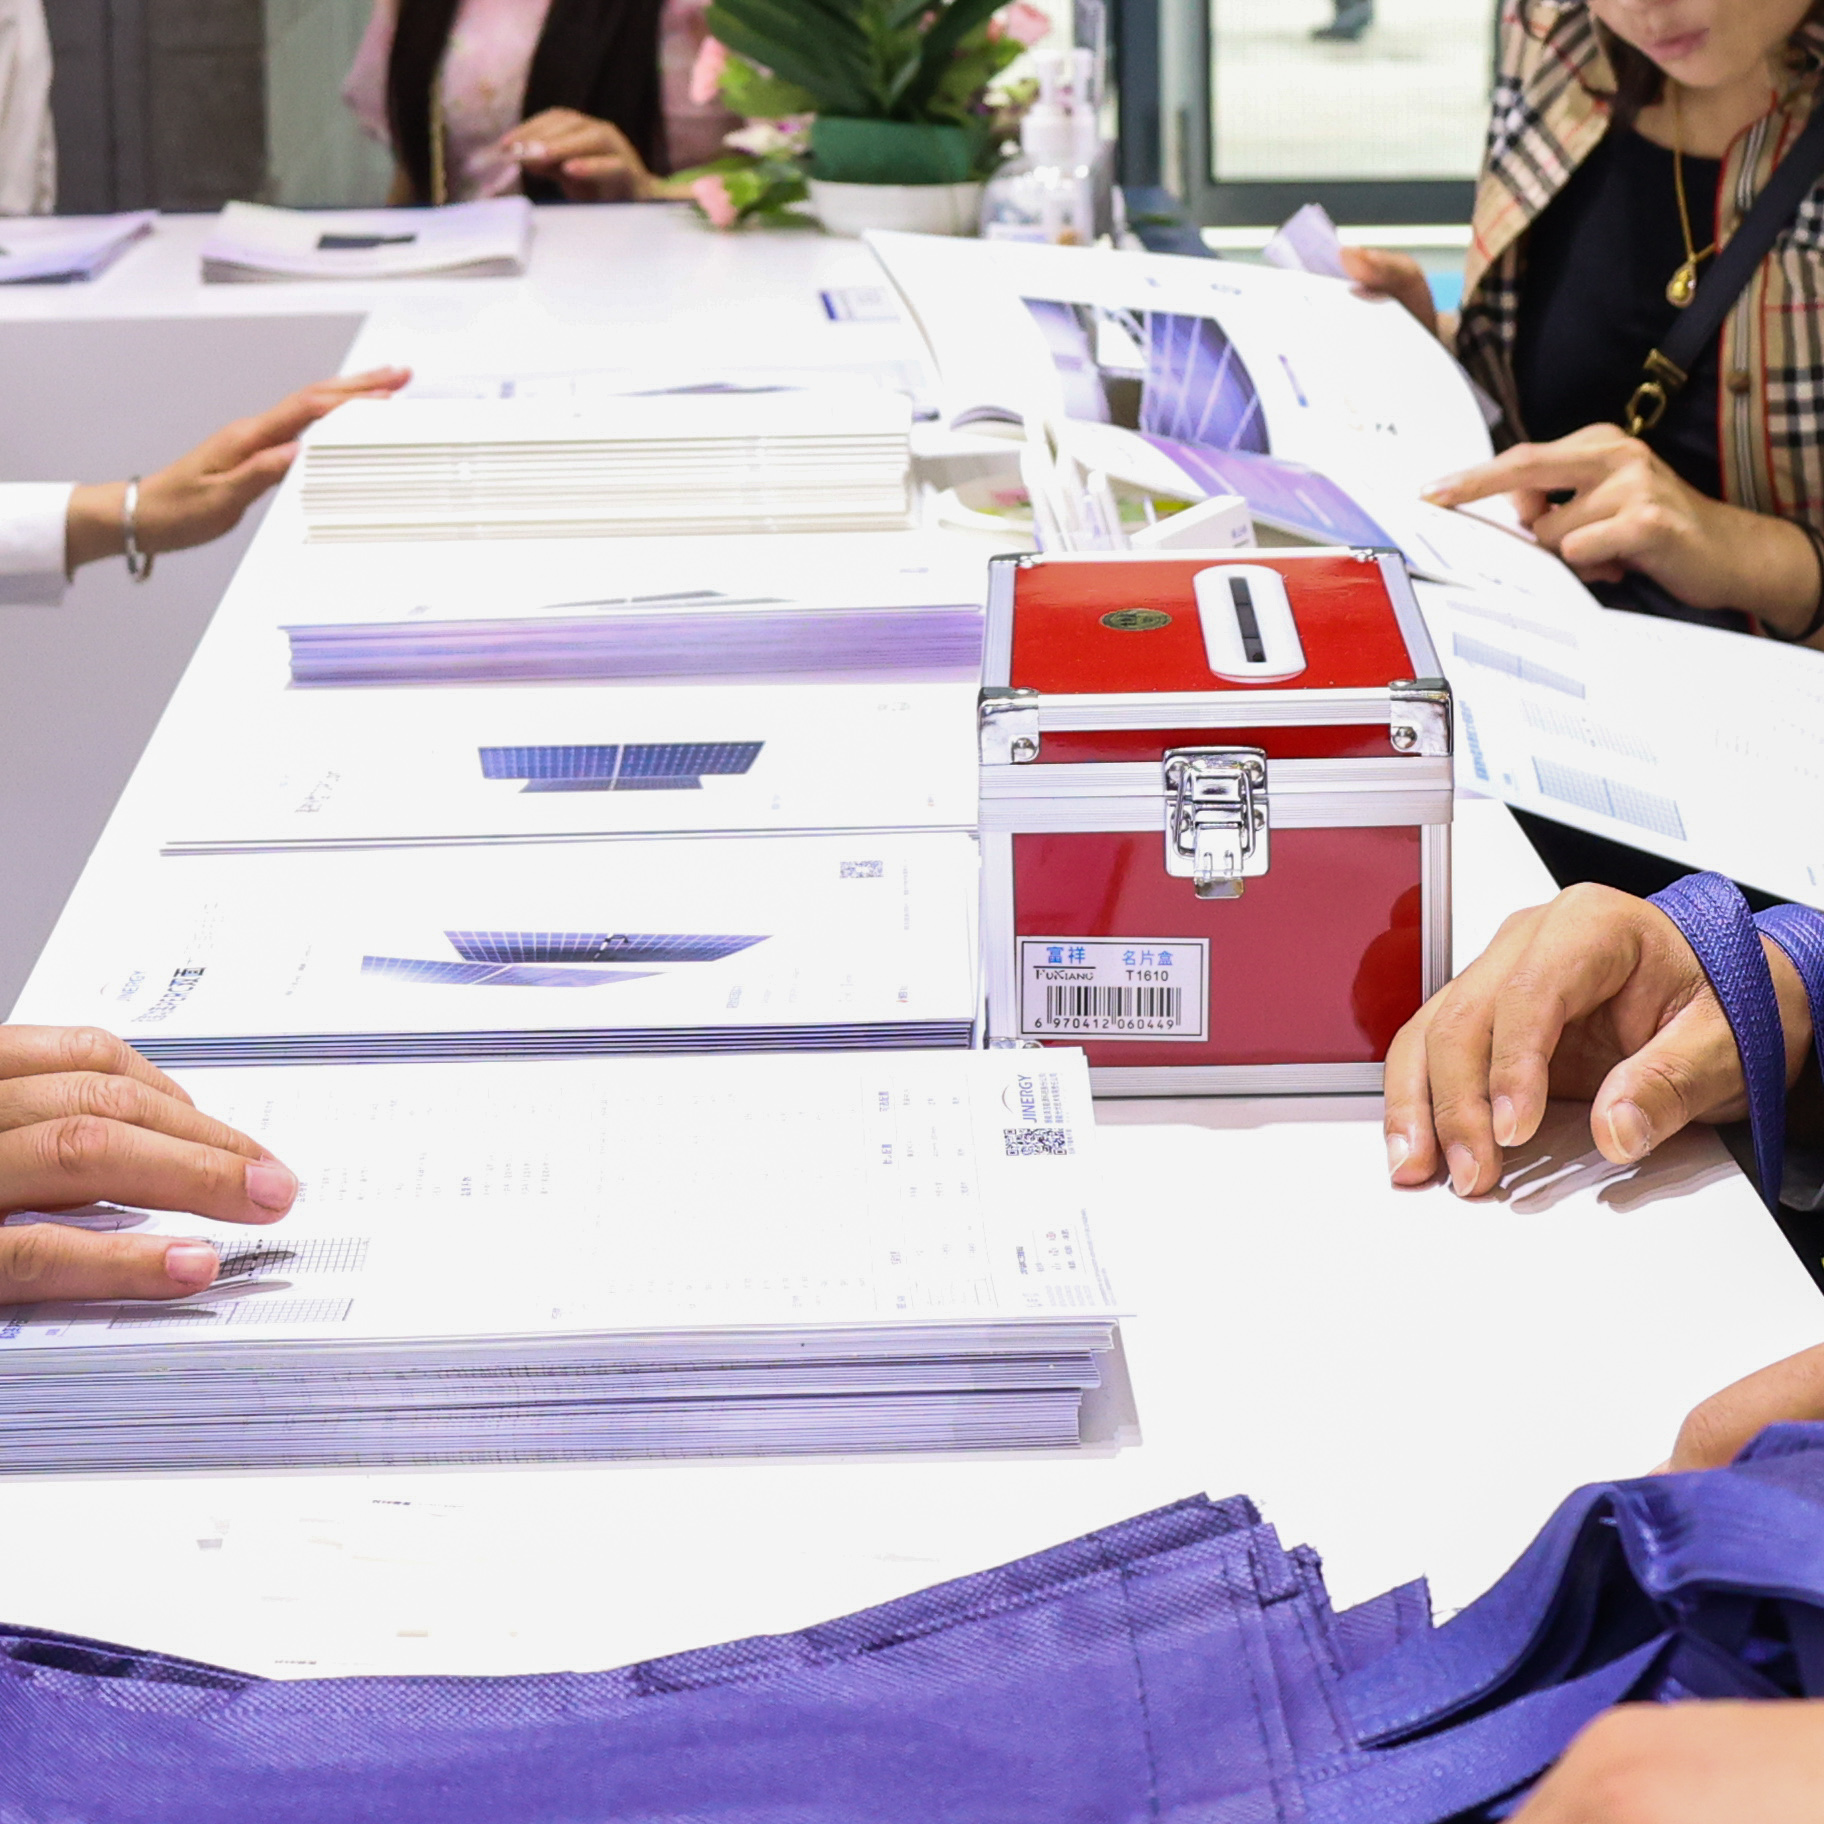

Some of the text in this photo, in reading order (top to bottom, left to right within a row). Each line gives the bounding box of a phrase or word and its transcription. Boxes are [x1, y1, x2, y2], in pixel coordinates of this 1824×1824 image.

[1046, 946, 1086, 964] 富祥
[1122, 950, 1173, 966] 名片盒
[1126, 970, 1169, 982] T1610
[1017, 1074, 1037, 1123] JINERGY
